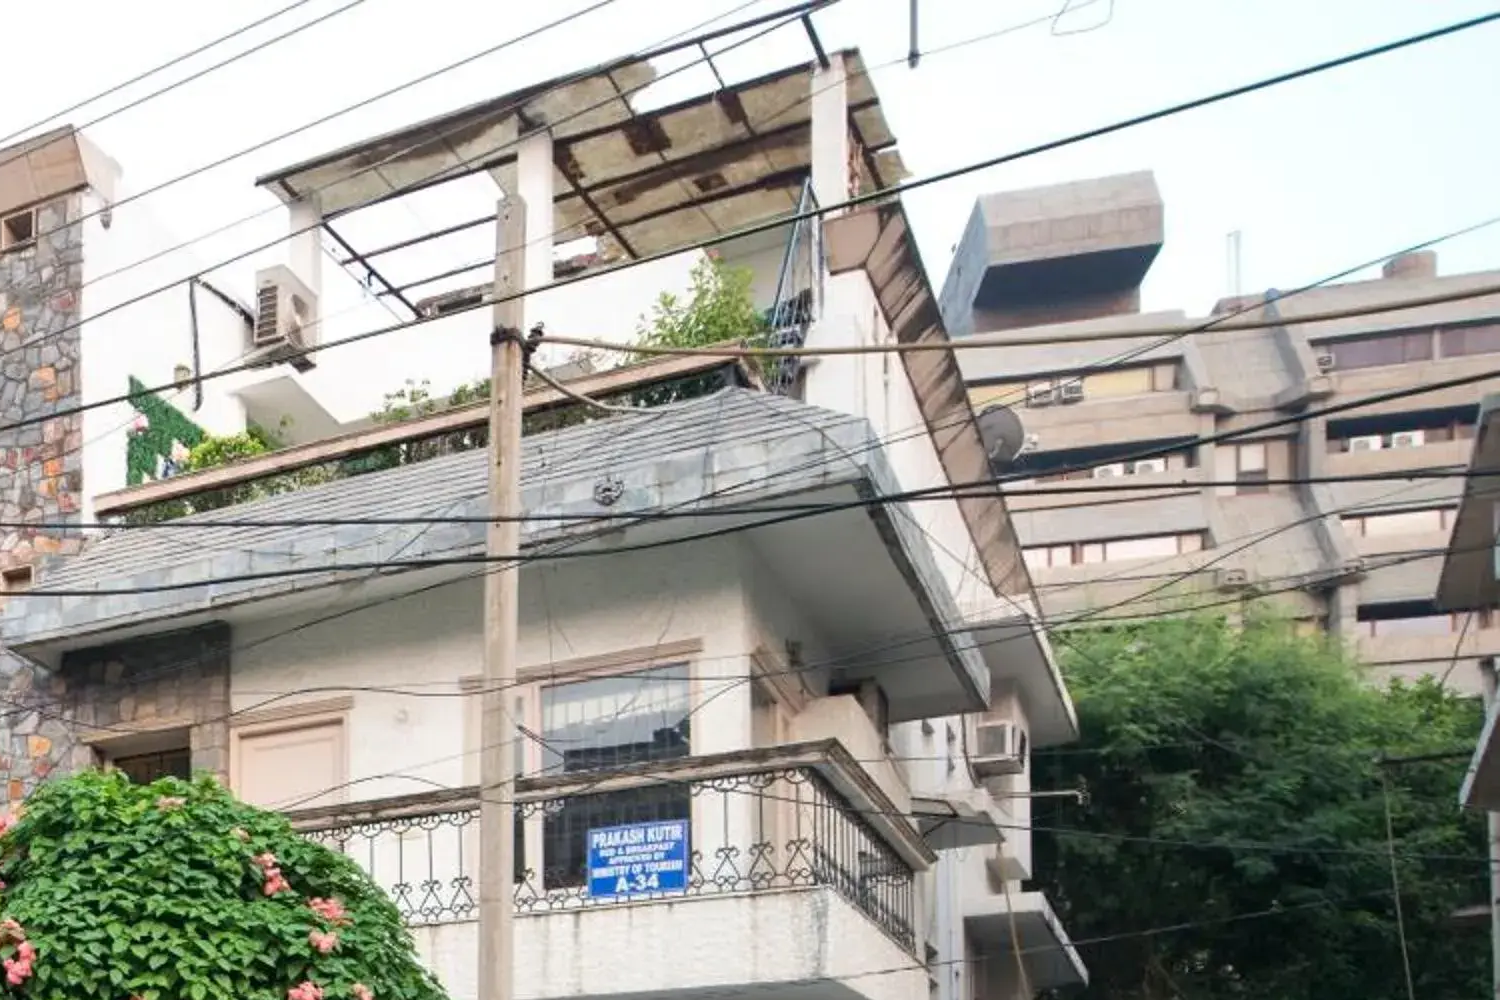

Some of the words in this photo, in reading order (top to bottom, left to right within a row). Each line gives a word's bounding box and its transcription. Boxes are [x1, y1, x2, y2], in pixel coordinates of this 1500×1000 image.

[592, 829, 645, 849] PRAKASH
[647, 825, 683, 842] KUTIR
[625, 842, 675, 855] BREAKFAST
[592, 864, 630, 878] MINISTRY
[632, 863, 643, 873] OF
[645, 860, 683, 872] TOURISM
[615, 873, 659, 892] A-34
